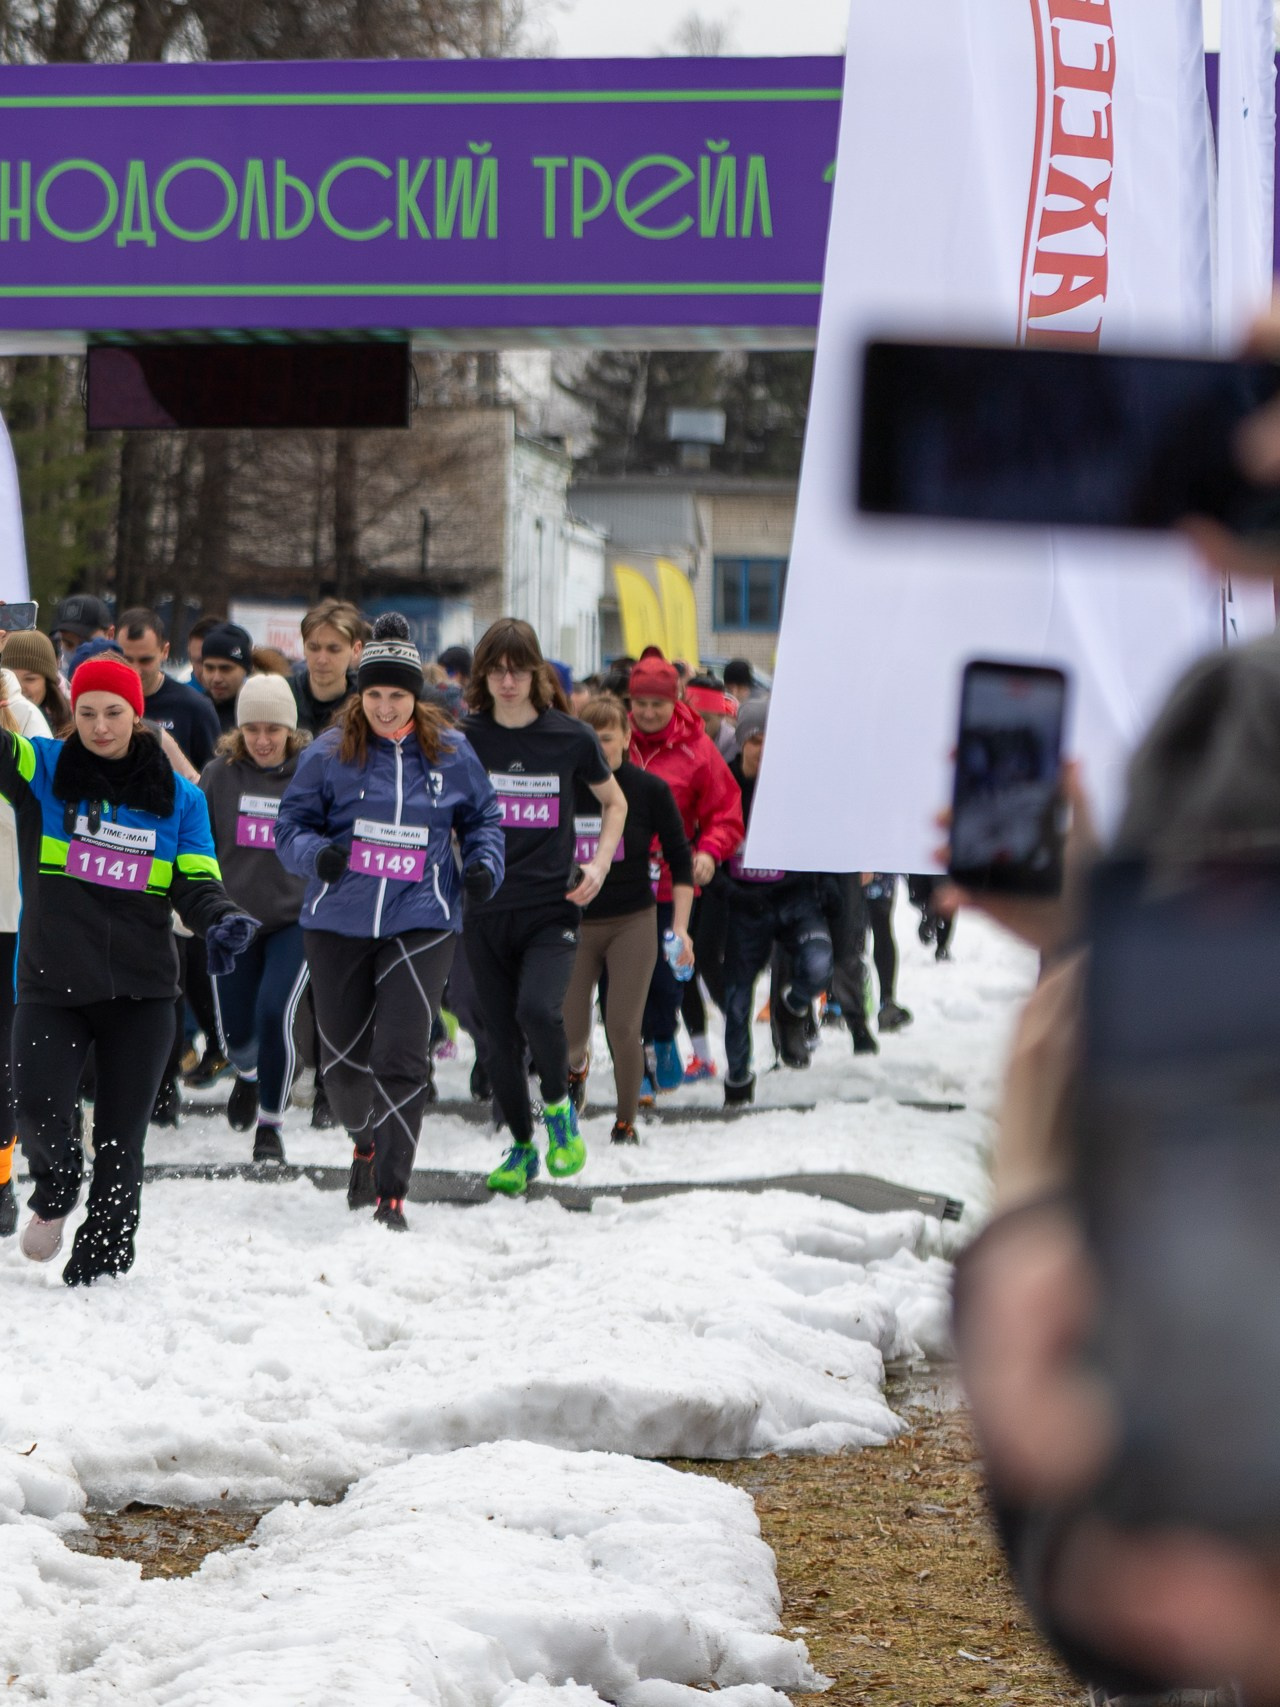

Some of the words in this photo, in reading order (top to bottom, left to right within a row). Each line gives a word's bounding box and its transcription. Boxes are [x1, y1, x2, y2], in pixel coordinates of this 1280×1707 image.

[499, 802, 550, 822] 1144
[79, 852, 139, 883] 1141
[361, 850, 416, 875] 1149
